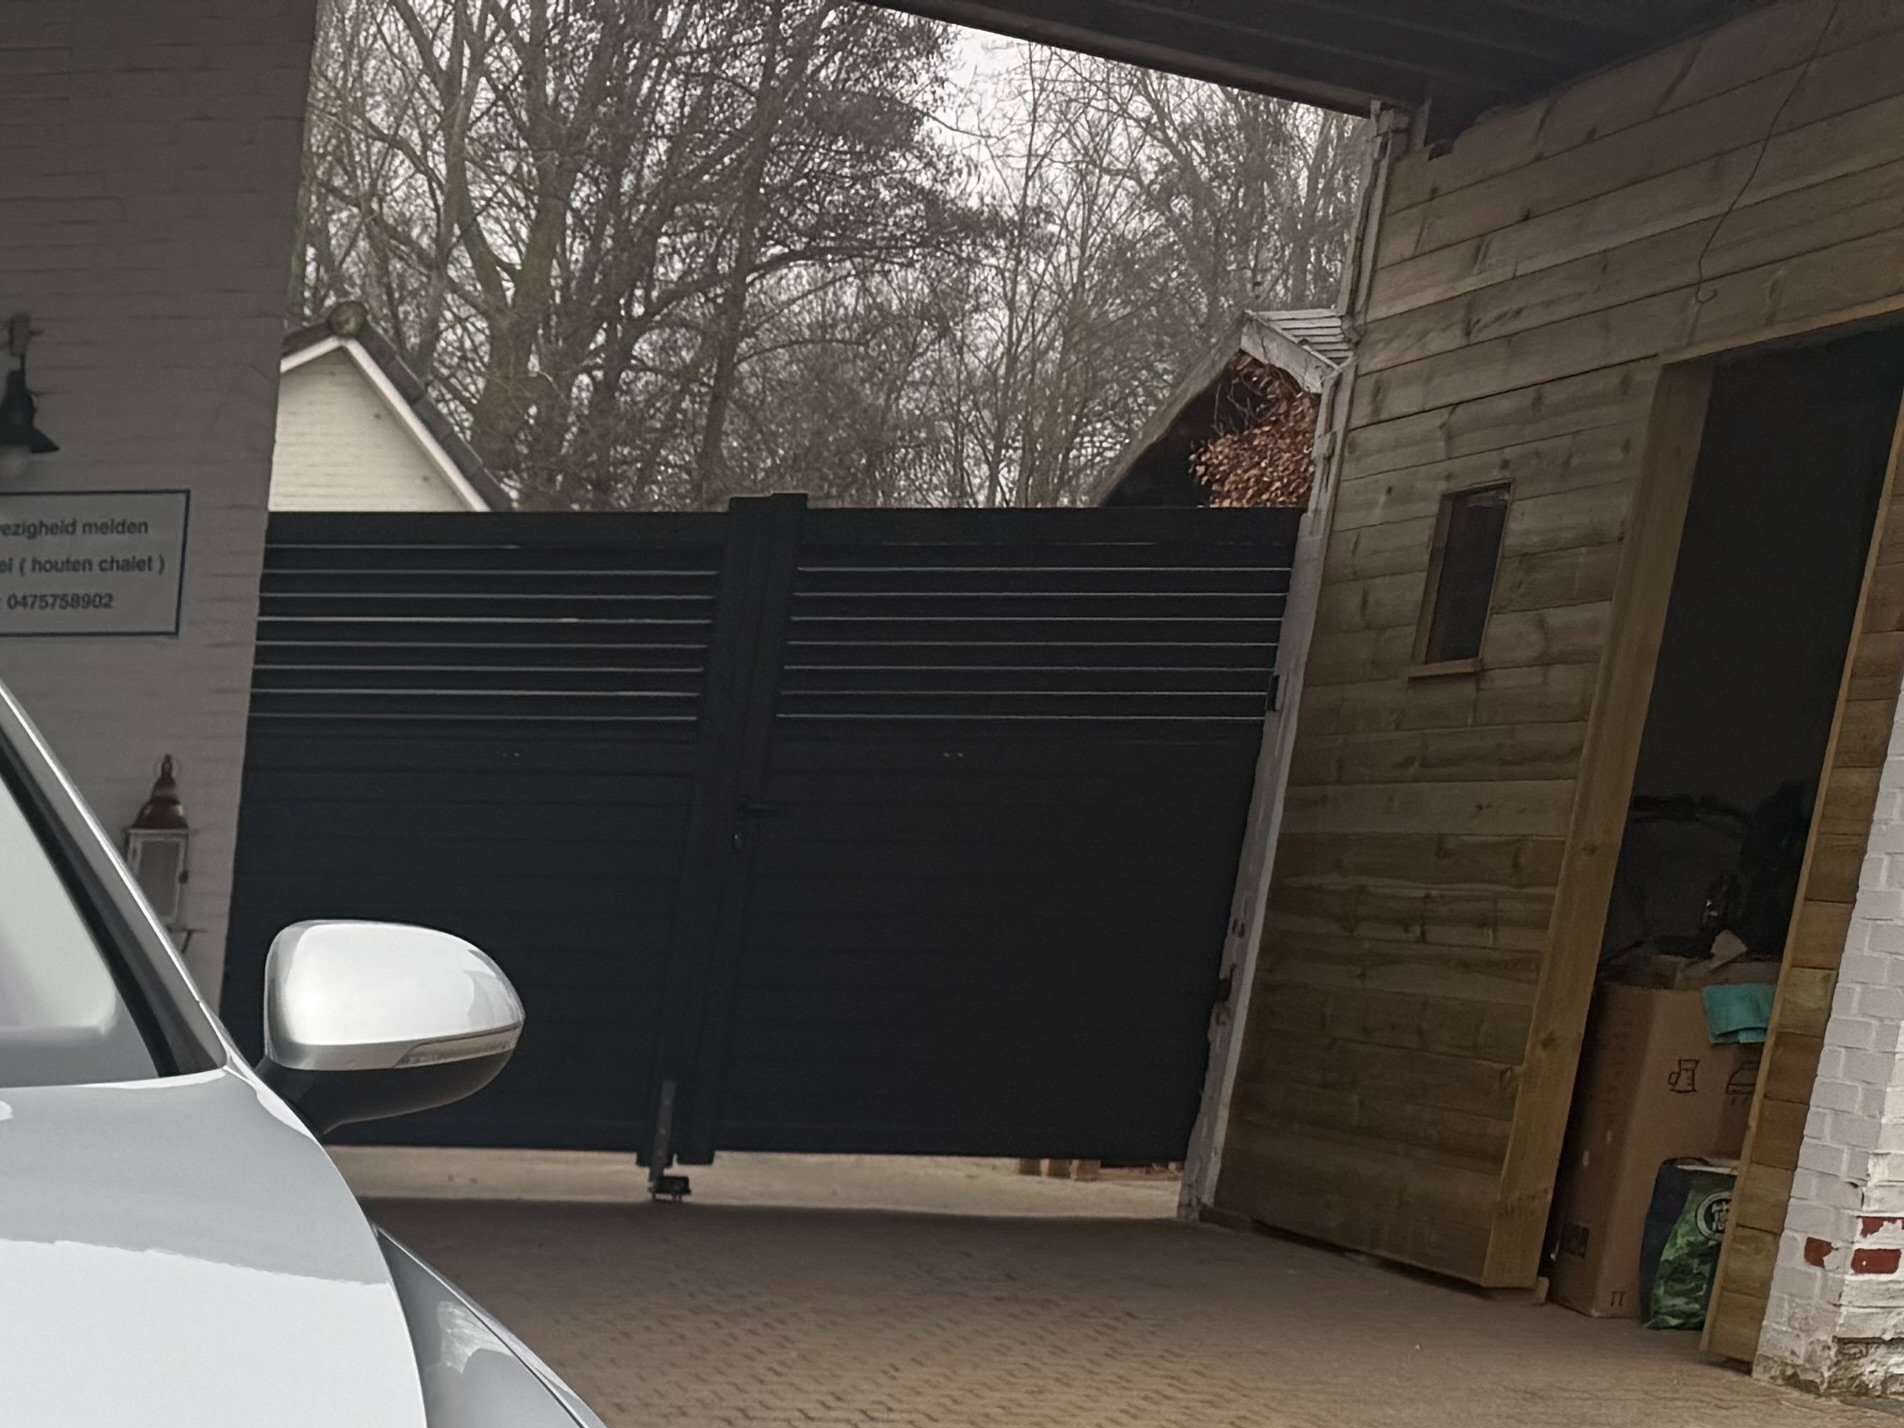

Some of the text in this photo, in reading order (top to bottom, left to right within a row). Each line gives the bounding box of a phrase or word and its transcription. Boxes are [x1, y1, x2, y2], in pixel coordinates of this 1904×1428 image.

[82, 518, 149, 535] melden
[31, 556, 93, 573] houten
[98, 555, 153, 572] chalet
